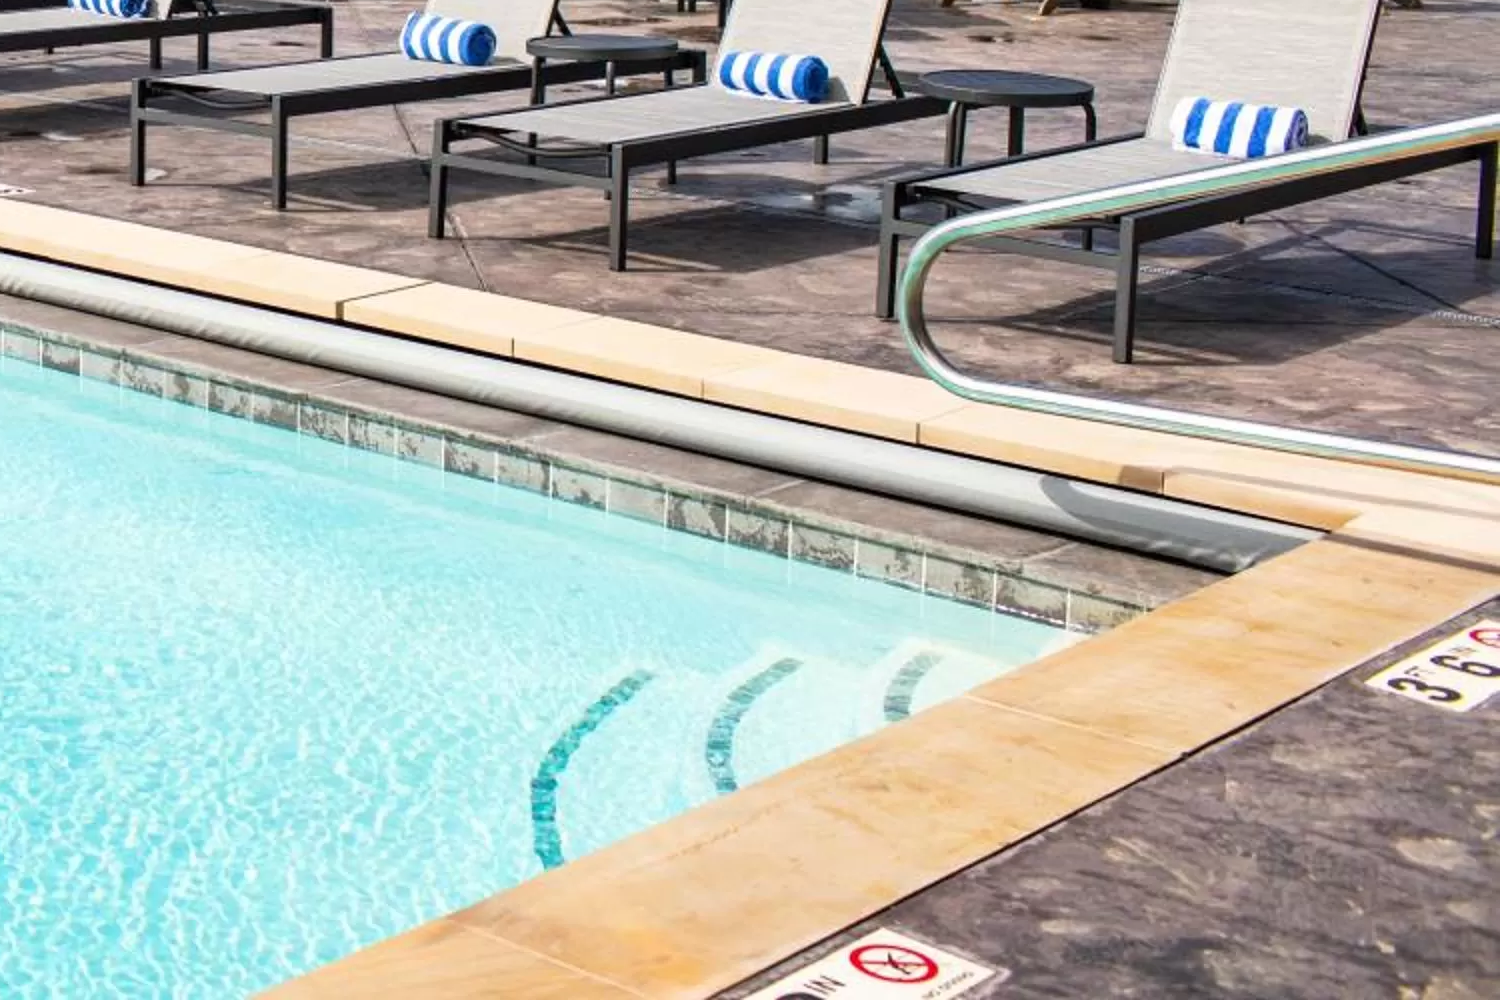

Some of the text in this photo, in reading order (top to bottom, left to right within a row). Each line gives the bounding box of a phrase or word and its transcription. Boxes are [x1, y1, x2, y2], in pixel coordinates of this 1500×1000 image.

[1387, 677, 1462, 702] 3
[1429, 655, 1500, 677] 6
[803, 974, 846, 996] IN
